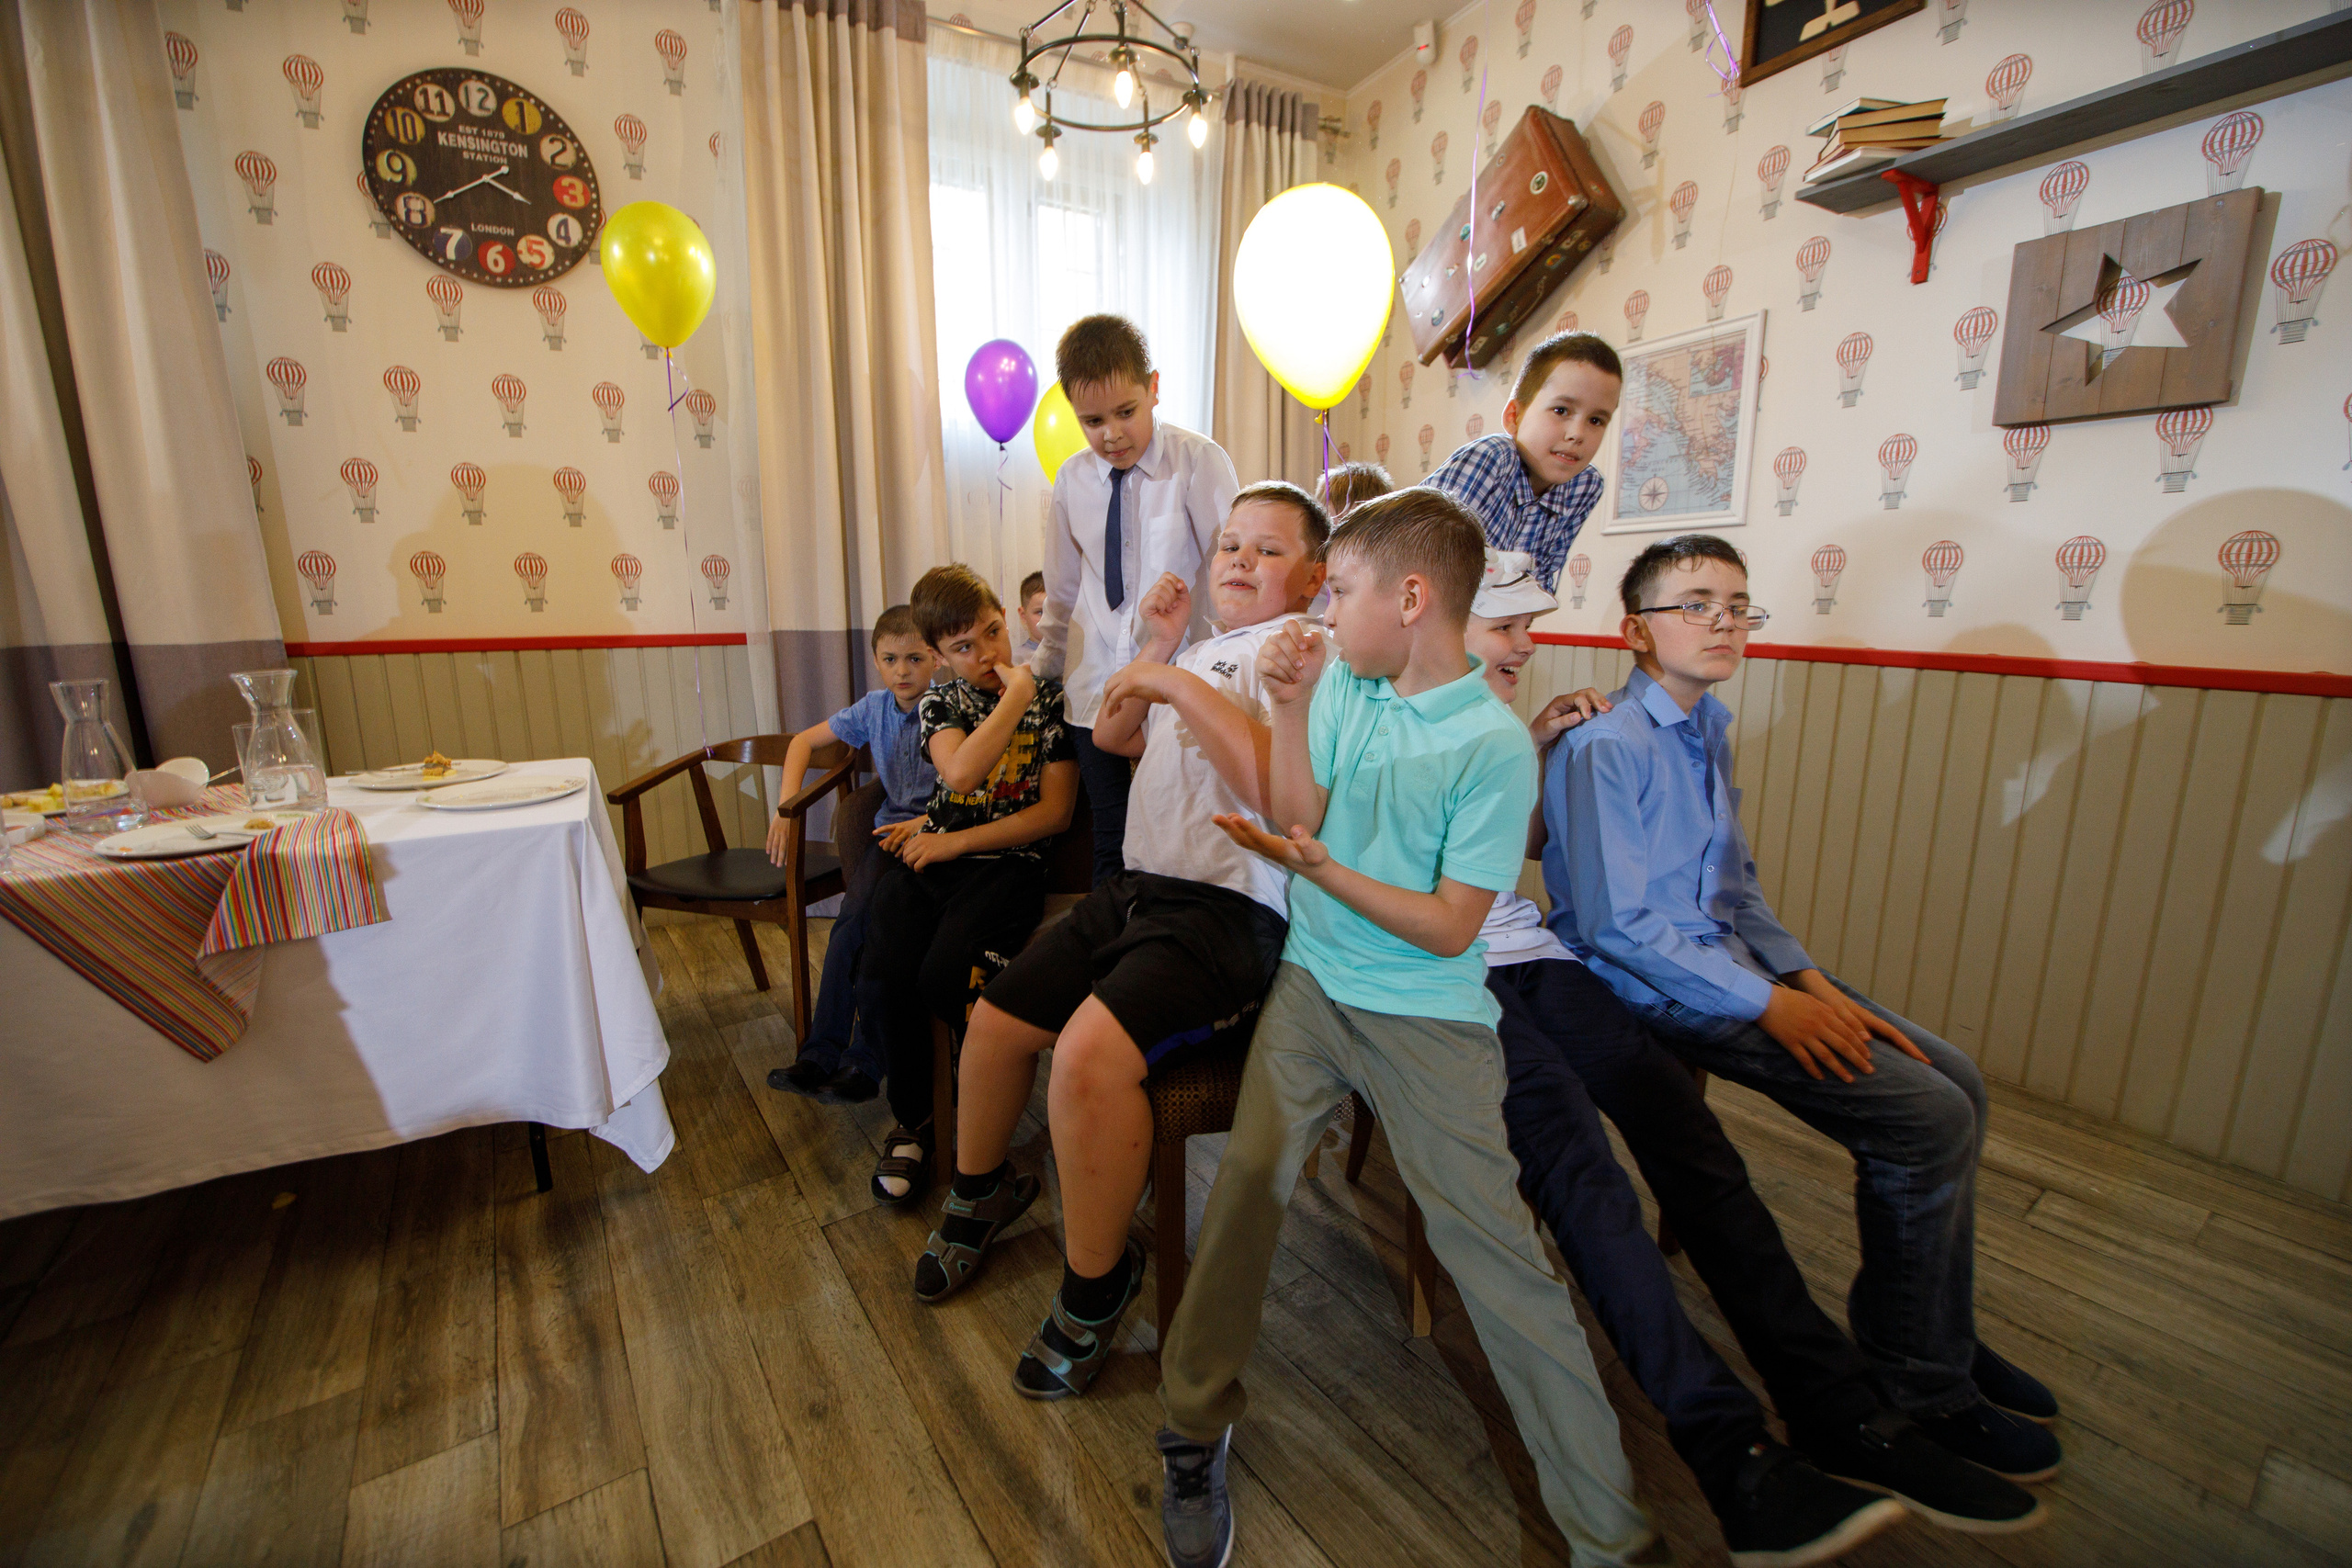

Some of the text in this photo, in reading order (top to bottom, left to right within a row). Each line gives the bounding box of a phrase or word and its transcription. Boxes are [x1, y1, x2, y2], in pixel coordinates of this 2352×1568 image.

[418, 87, 450, 118] 11
[463, 84, 492, 112] 12
[390, 109, 417, 143] 10
[458, 124, 478, 135] EST
[514, 100, 528, 133] 1
[437, 130, 528, 159] KENSINGTON
[462, 150, 508, 165] STATION
[548, 136, 570, 166] 2
[383, 151, 411, 186] 9
[560, 179, 585, 208] 3
[402, 196, 426, 226] 8
[470, 221, 514, 236] LONDON
[556, 218, 571, 244] 4
[440, 228, 462, 260] 7
[526, 239, 546, 268] 5
[486, 245, 505, 274] 6
